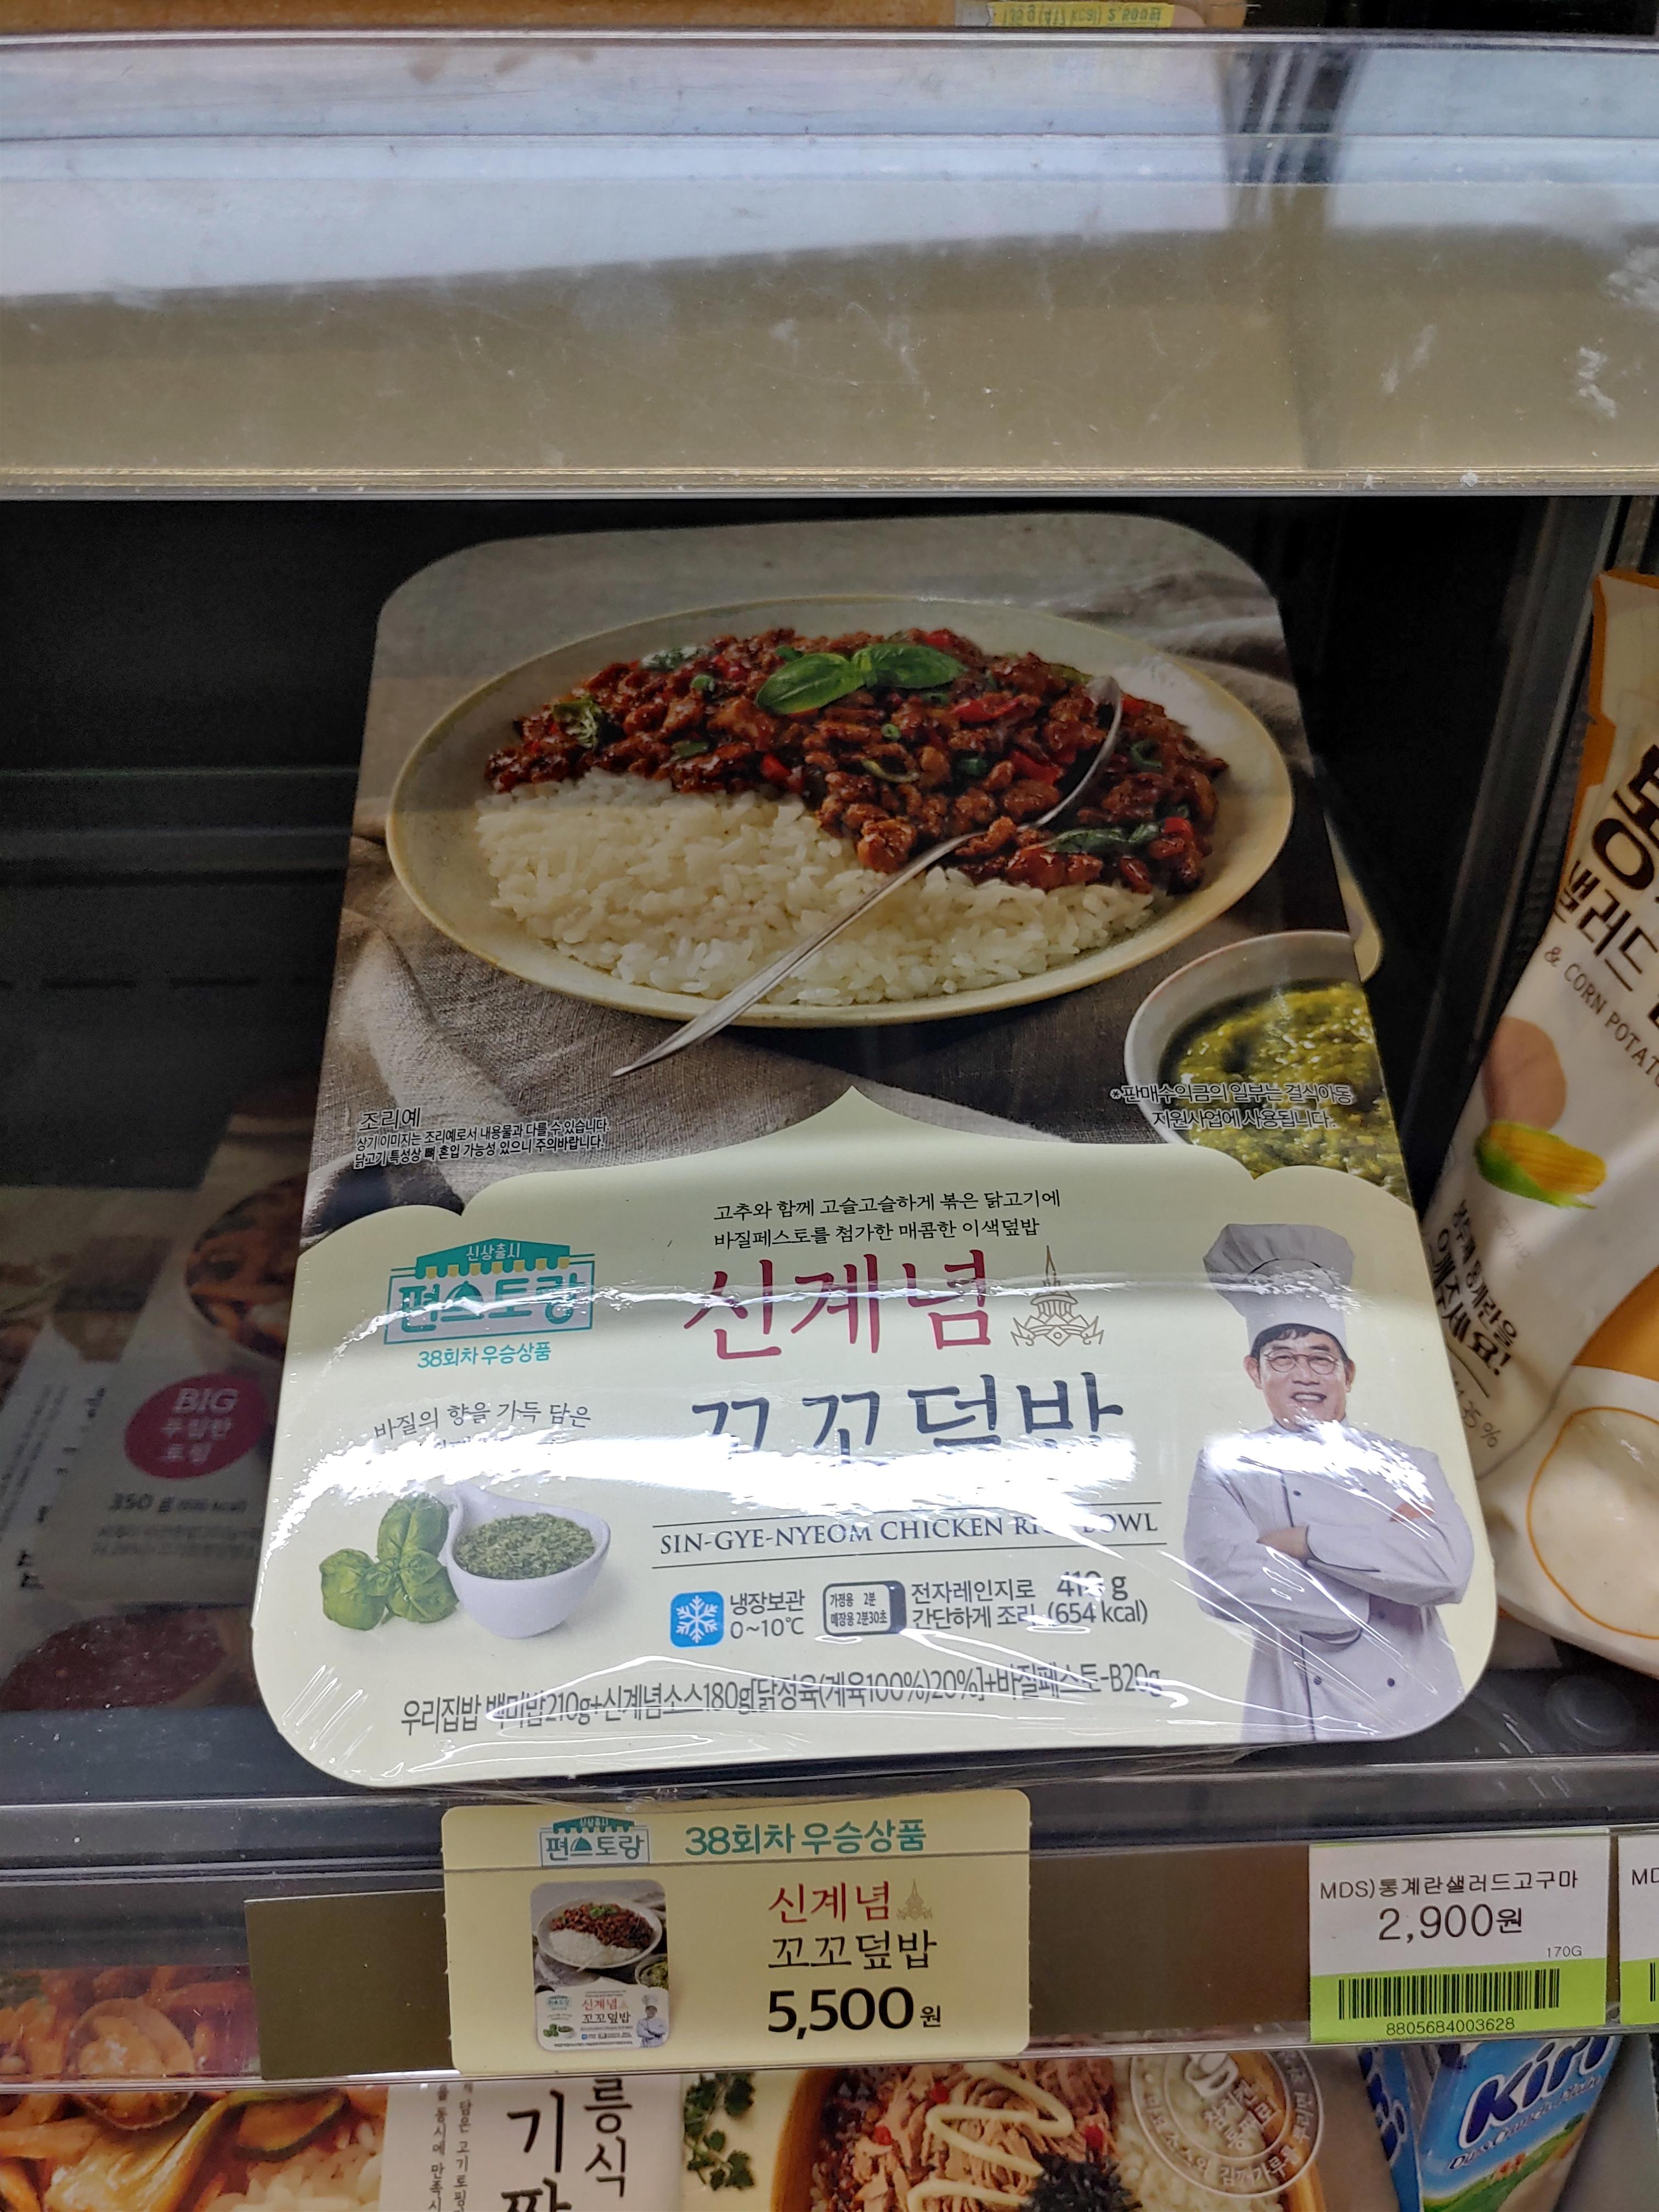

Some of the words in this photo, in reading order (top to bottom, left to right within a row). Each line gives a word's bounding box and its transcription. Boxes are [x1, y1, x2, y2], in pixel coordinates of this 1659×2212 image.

[1564, 963, 1607, 1015] CORN
[1230, 1083, 1283, 1103] 일부는
[1285, 1084, 1353, 1105] 결식아동
[359, 1107, 421, 1131] 조리예
[1152, 1109, 1242, 1129] 지원사업에
[1242, 1108, 1336, 1128] 사용됩니다.
[357, 1136, 378, 1152] 상기
[380, 1132, 422, 1149] 이미지는
[424, 1126, 478, 1144] 조리예로서
[480, 1123, 523, 1141] 내용물과
[526, 1122, 548, 1137] 다를
[550, 1121, 562, 1136] 수
[564, 1118, 610, 1135] 있습니다.
[355, 1150, 386, 1169] 닭고기
[389, 1147, 422, 1164] 특성상
[438, 1144, 460, 1160] 혼입
[463, 1141, 496, 1158] 가능성
[500, 1139, 532, 1156] 있으니
[535, 1134, 605, 1153] 주의바랍니다.
[714, 1200, 773, 1222] 고추와
[776, 1198, 815, 1218] 함께
[820, 1193, 934, 1215] 고슬고슬하게
[940, 1192, 979, 1211] 볶은
[984, 1189, 1061, 1209] 닭고기에
[714, 1227, 830, 1250] 바질페스토를
[836, 1222, 894, 1243] 첨가한
[898, 1220, 957, 1240] 매콤한
[962, 1217, 1040, 1238] 이색덮밥
[465, 1242, 522, 1262] 신상출시
[684, 1249, 992, 1361] 신계념
[481, 1341, 552, 1367] 우승상품
[172, 1387, 239, 1415] BIG
[374, 1406, 439, 1441] 바질의
[447, 1401, 492, 1426] 향을
[496, 1399, 542, 1426] 가득
[549, 1402, 592, 1429] 담은
[660, 1523, 874, 1555] SIN-GYE-NYEOM
[880, 1516, 1004, 1541] CHICKEN
[1082, 1513, 1158, 1533] OWL
[730, 1589, 805, 1616] 냉장보관
[863, 1591, 877, 1607] 2분
[911, 1578, 1036, 1605] 전자레인지로
[1111, 1576, 1128, 1601] g
[831, 1611, 855, 1627] 매장용
[856, 1609, 888, 1626] 2분30초
[912, 1605, 992, 1629] 간단하게
[996, 1603, 1036, 1626] 조리
[1047, 1601, 1097, 1624] (654
[1101, 1599, 1148, 1625] kcal)
[400, 1694, 482, 1736] 우리집밥
[685, 1822, 794, 1858] 38회차
[801, 1818, 927, 1855] 우승상품
[1319, 1869, 1578, 1900] MDS)통계란샐러드고구마
[768, 1879, 891, 1925] 신계념
[1379, 1903, 1523, 1944] 2,900원
[768, 1927, 938, 1971] 꼬꼬덮밥
[1545, 1945, 1583, 1959] 170G
[1386, 2017, 1515, 2036] 8805684003628
